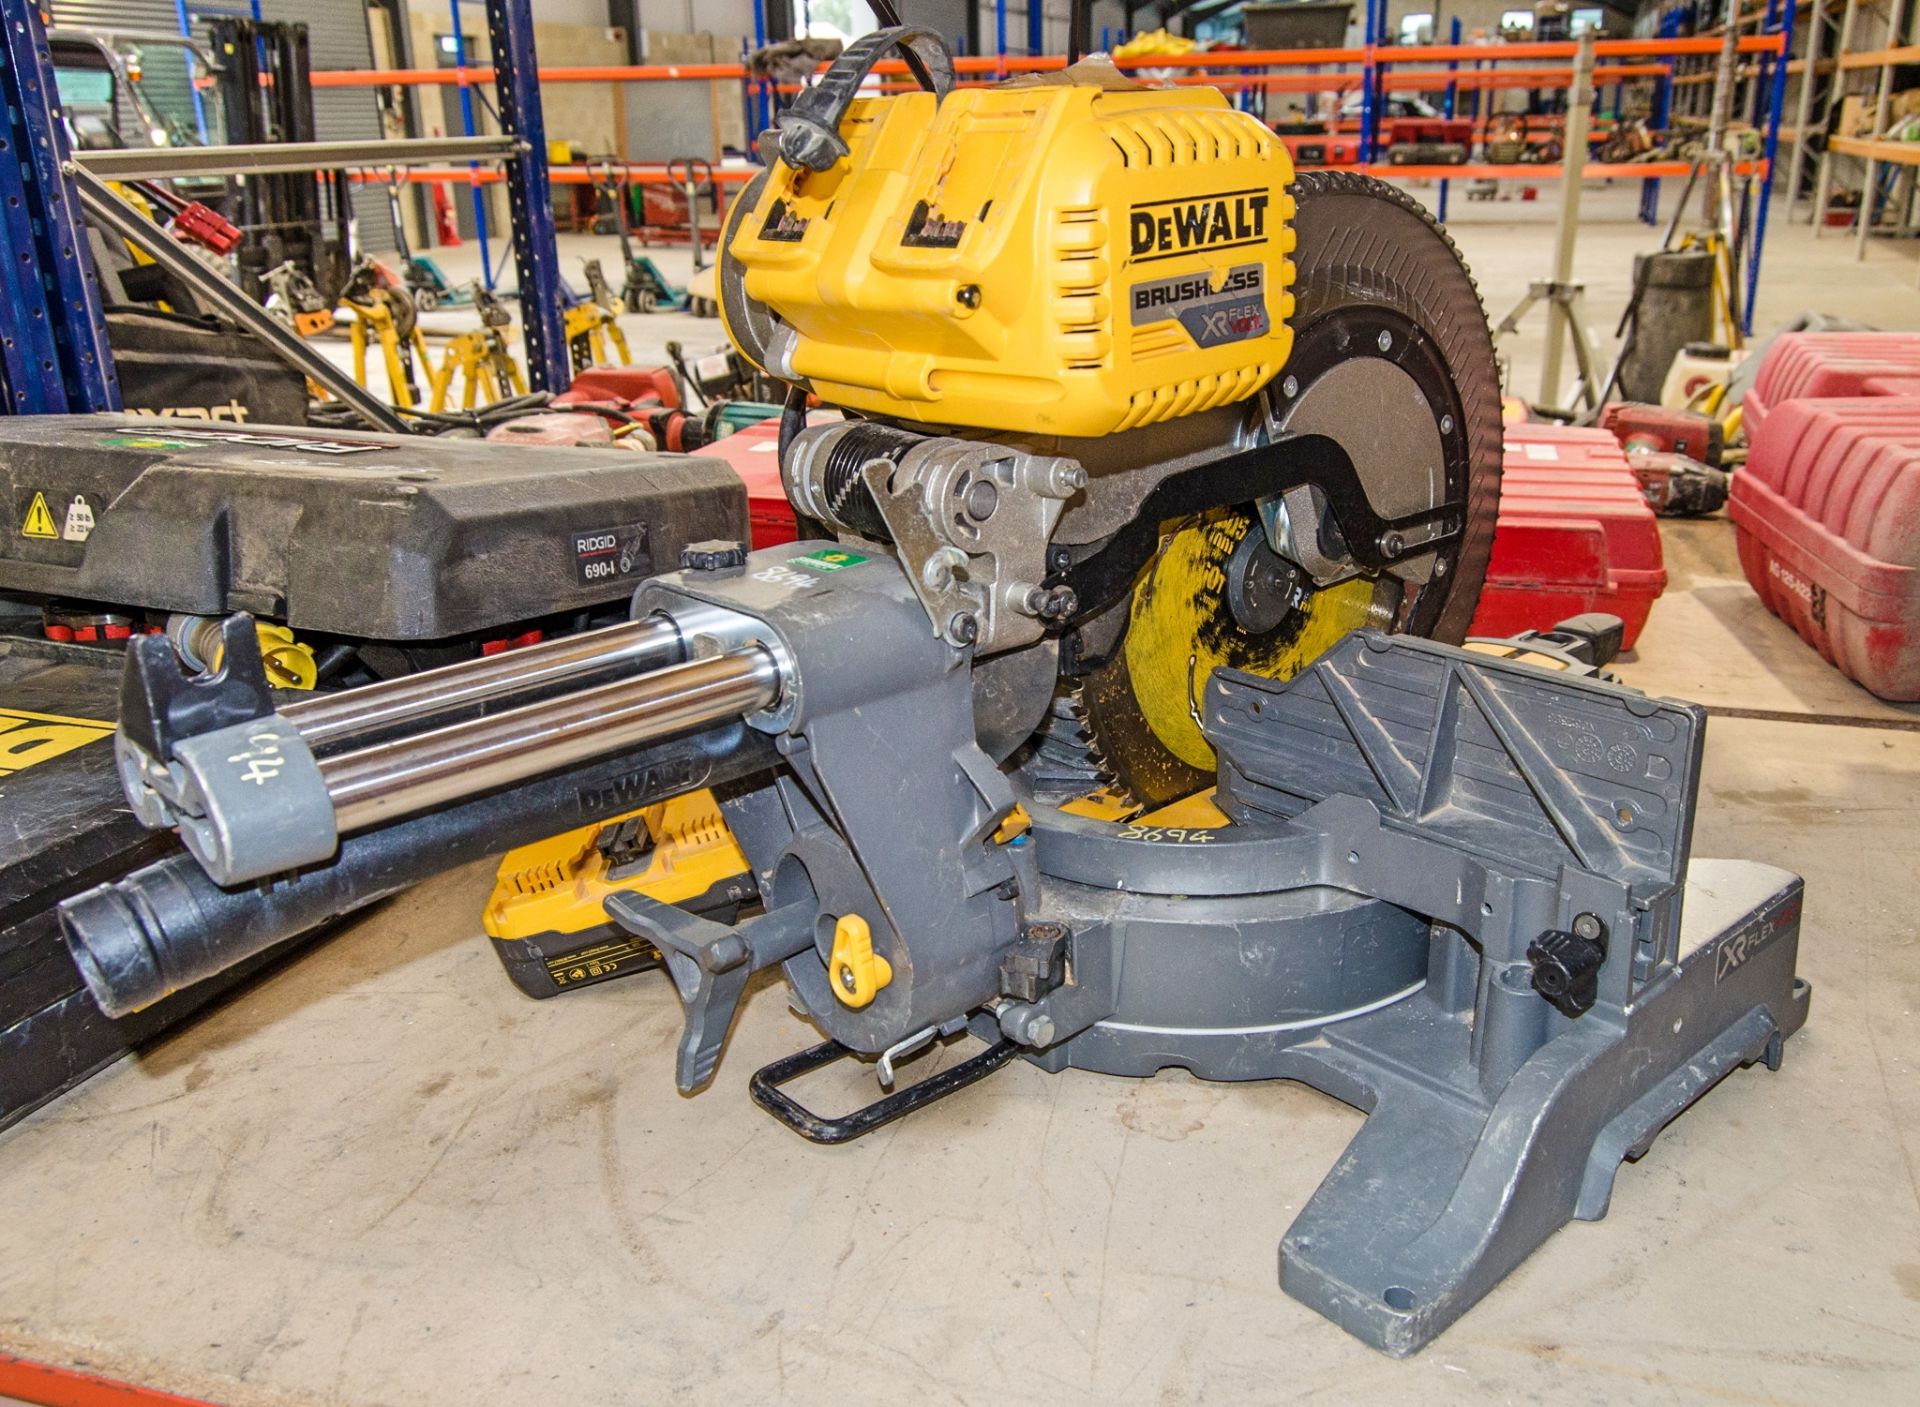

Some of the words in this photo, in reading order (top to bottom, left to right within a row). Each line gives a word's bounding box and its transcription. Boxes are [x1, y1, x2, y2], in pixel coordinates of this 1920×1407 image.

[1200, 310, 1230, 341] XR
[1228, 303, 1260, 319] FLEX
[577, 534, 616, 553] RIDGID
[1117, 824, 1216, 844] 8694
